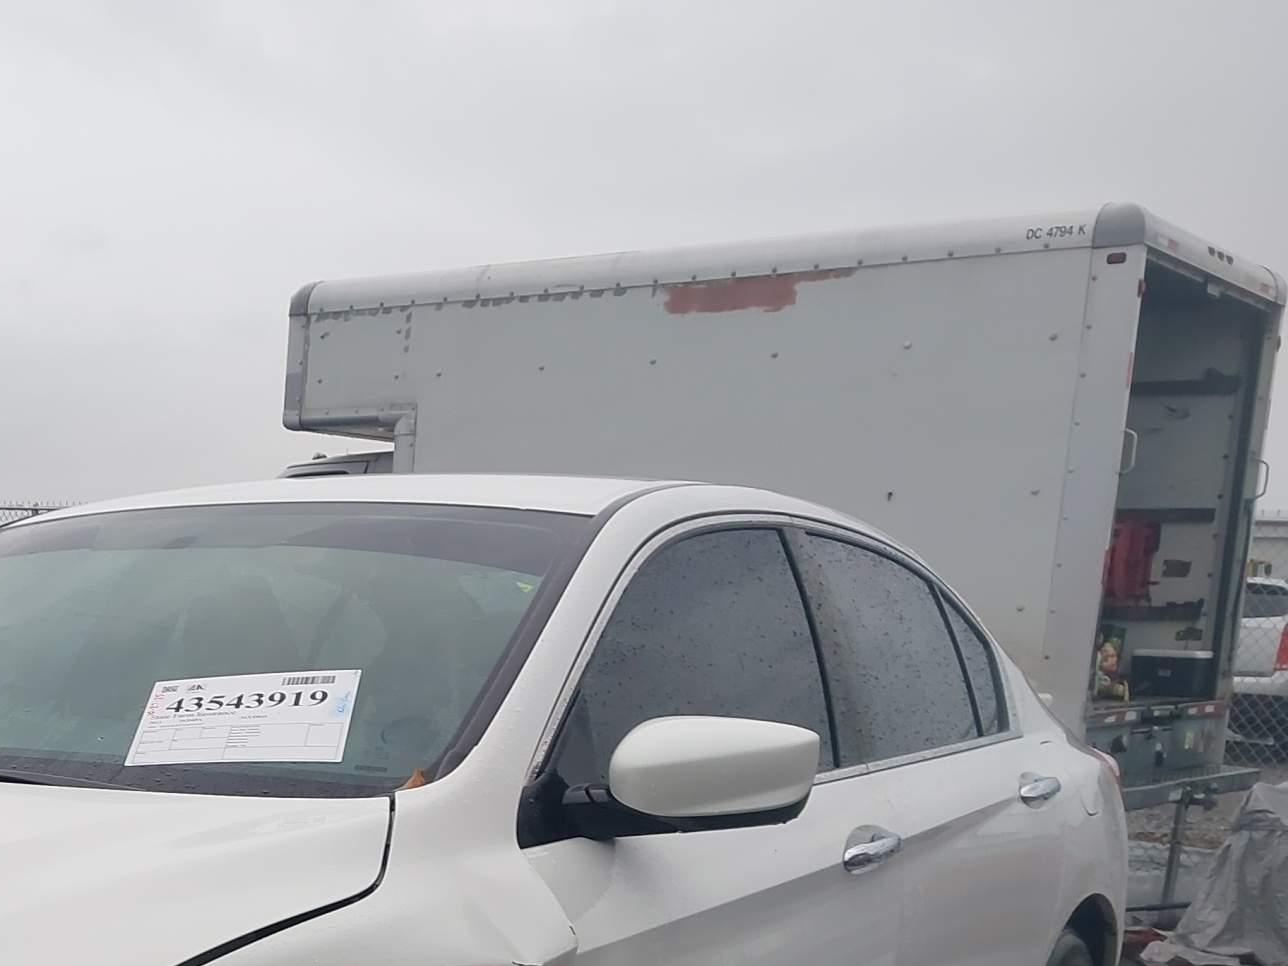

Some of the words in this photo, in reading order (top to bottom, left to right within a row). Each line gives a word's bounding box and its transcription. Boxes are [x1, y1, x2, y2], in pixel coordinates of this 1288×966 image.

[1026, 228, 1043, 241] DC
[1046, 225, 1074, 238] 4794
[1078, 224, 1087, 236] K
[165, 689, 329, 713] 43543919
